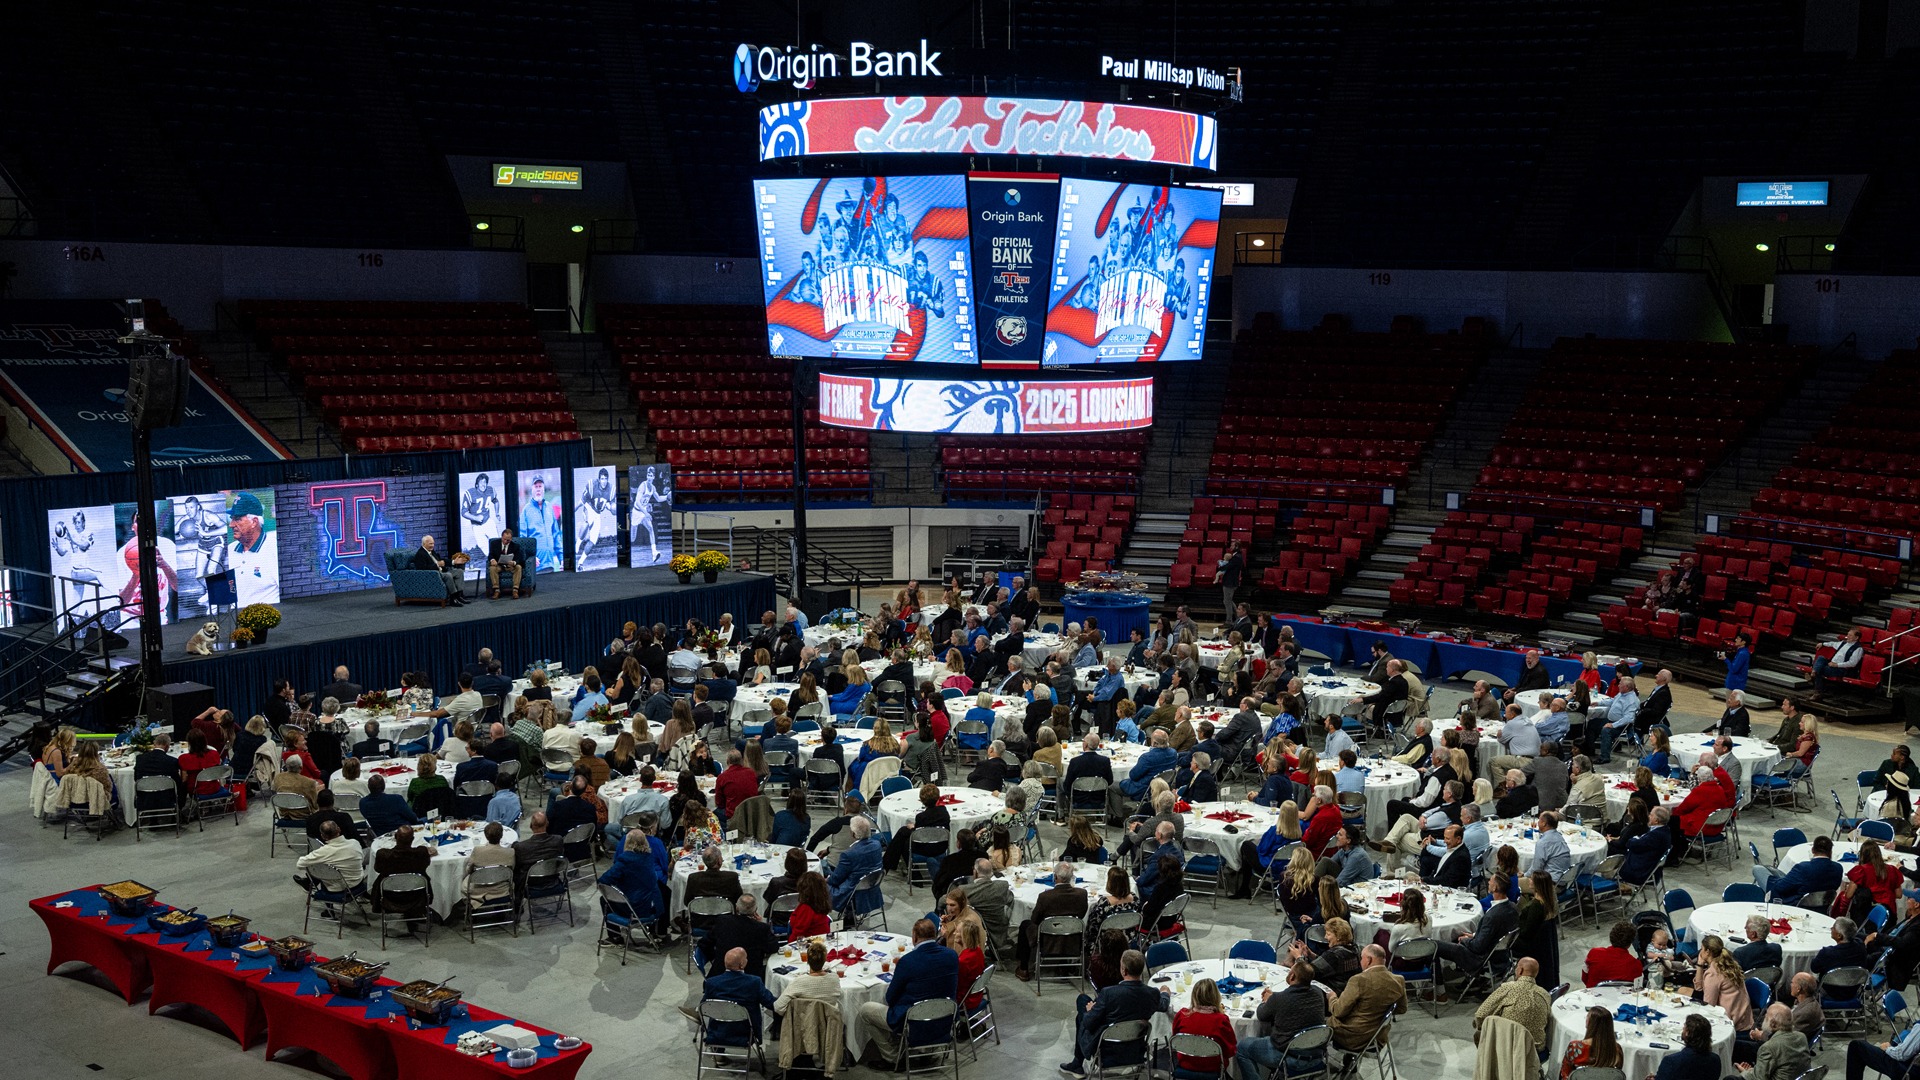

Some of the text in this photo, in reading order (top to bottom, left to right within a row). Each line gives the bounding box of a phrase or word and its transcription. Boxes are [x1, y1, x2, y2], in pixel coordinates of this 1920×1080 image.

[758, 39, 942, 89] Origin Bank
[1101, 55, 1138, 79] Paul
[1144, 60, 1193, 88] Millsap
[1197, 67, 1225, 91] Vision
[854, 97, 1155, 161] Lady Techsters
[515, 170, 579, 182] rapidSIGNS
[982, 211, 1044, 224] Origin Bank
[992, 236, 1033, 248] OFFICIAL
[358, 253, 383, 267] 116
[992, 248, 1033, 263] BANK
[1007, 263, 1017, 271] OF
[1369, 272, 1391, 286] 119
[1815, 278, 1840, 293] 101
[821, 266, 913, 337] HALL OF FAME
[994, 295, 1029, 304] ATHLETICS
[1095, 273, 1126, 339] HALL
[1138, 271, 1167, 338] FAME
[832, 383, 864, 421] FAME
[1025, 387, 1078, 425] 2025
[1080, 384, 1146, 424] LOUISIANA
[189, 453, 252, 465] Louisiana
